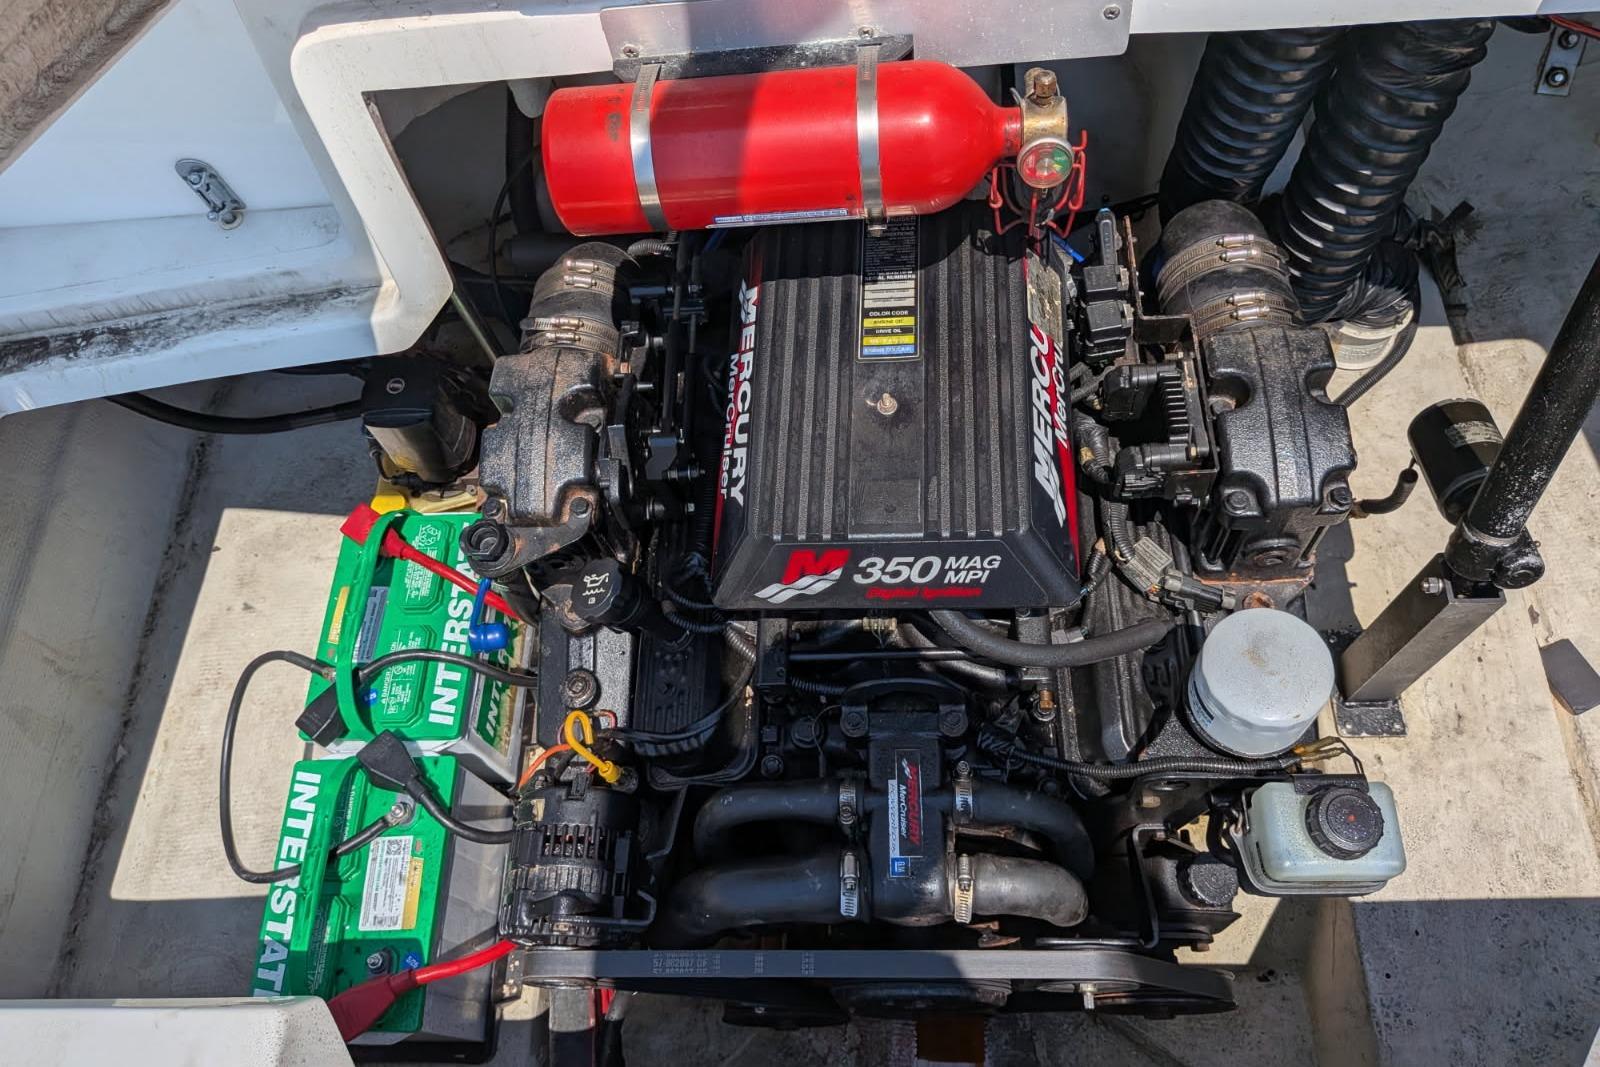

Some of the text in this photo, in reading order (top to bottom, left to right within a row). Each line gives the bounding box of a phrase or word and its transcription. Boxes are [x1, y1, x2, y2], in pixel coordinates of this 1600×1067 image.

[721, 353, 739, 501] MerCruiser
[731, 286, 758, 507] MERCURY
[1030, 326, 1057, 500] MERCU
[853, 555, 1001, 584] 350 MAG
[944, 570, 990, 584] MPI
[252, 771, 322, 997] INTERSTAT
[899, 784, 907, 839] MerCruiser
